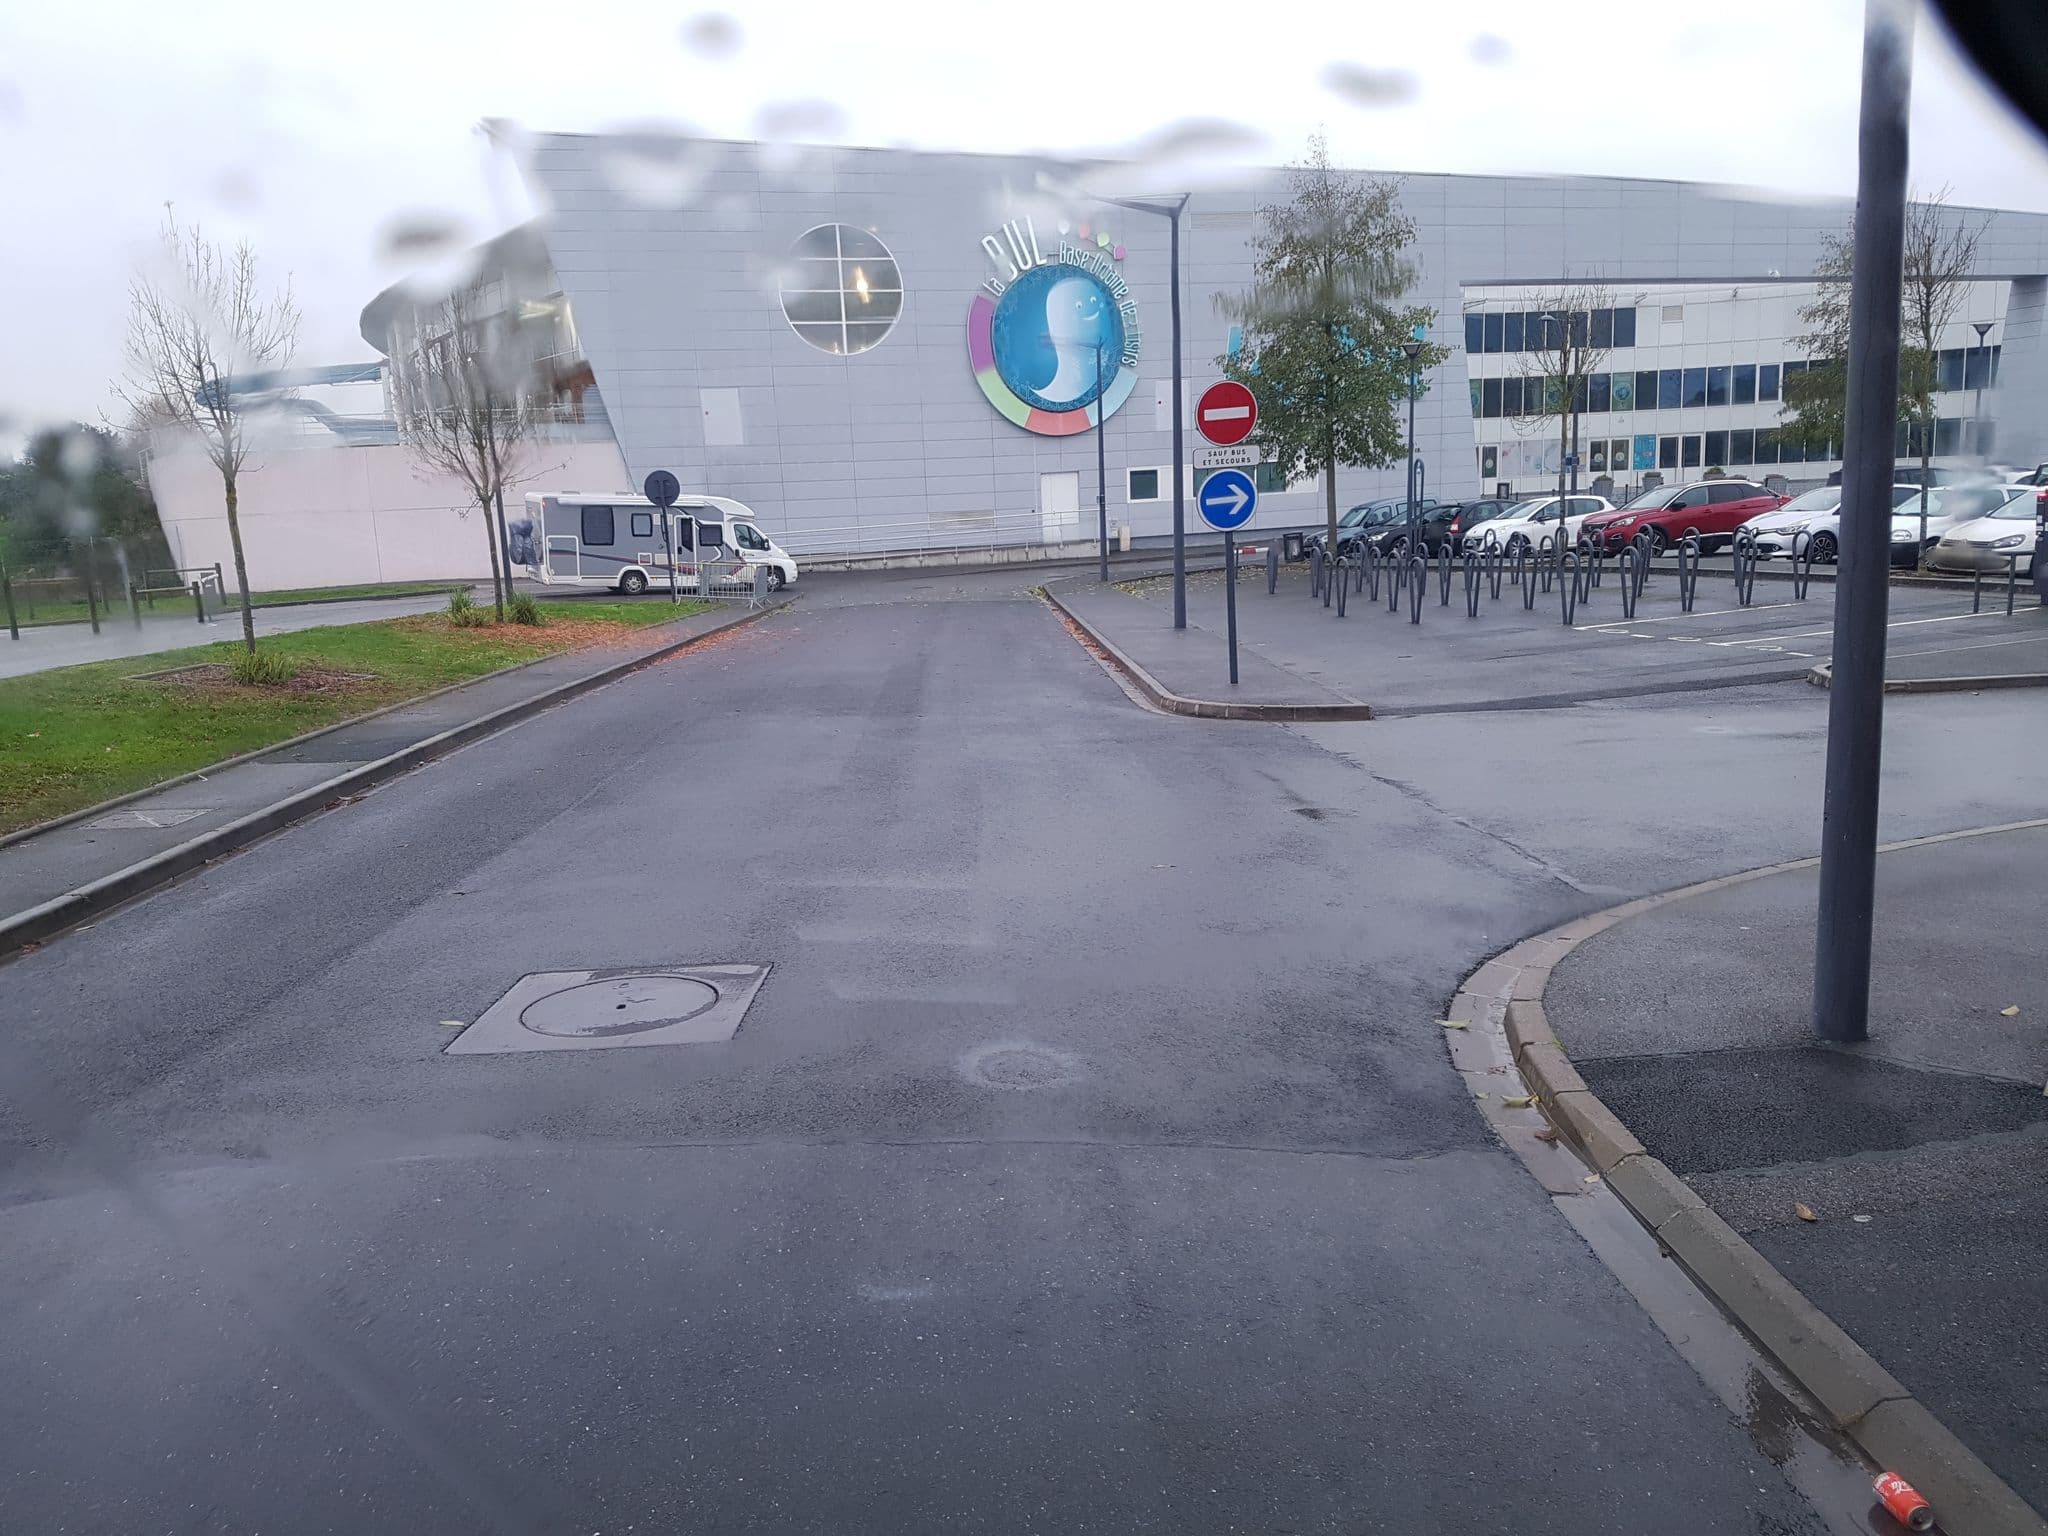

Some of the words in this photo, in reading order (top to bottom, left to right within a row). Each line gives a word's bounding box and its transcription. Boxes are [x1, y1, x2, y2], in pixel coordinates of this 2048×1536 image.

[1059, 240, 1090, 268] Base
[1119, 299, 1137, 317] de
[1215, 457, 1251, 465] SECOURS
